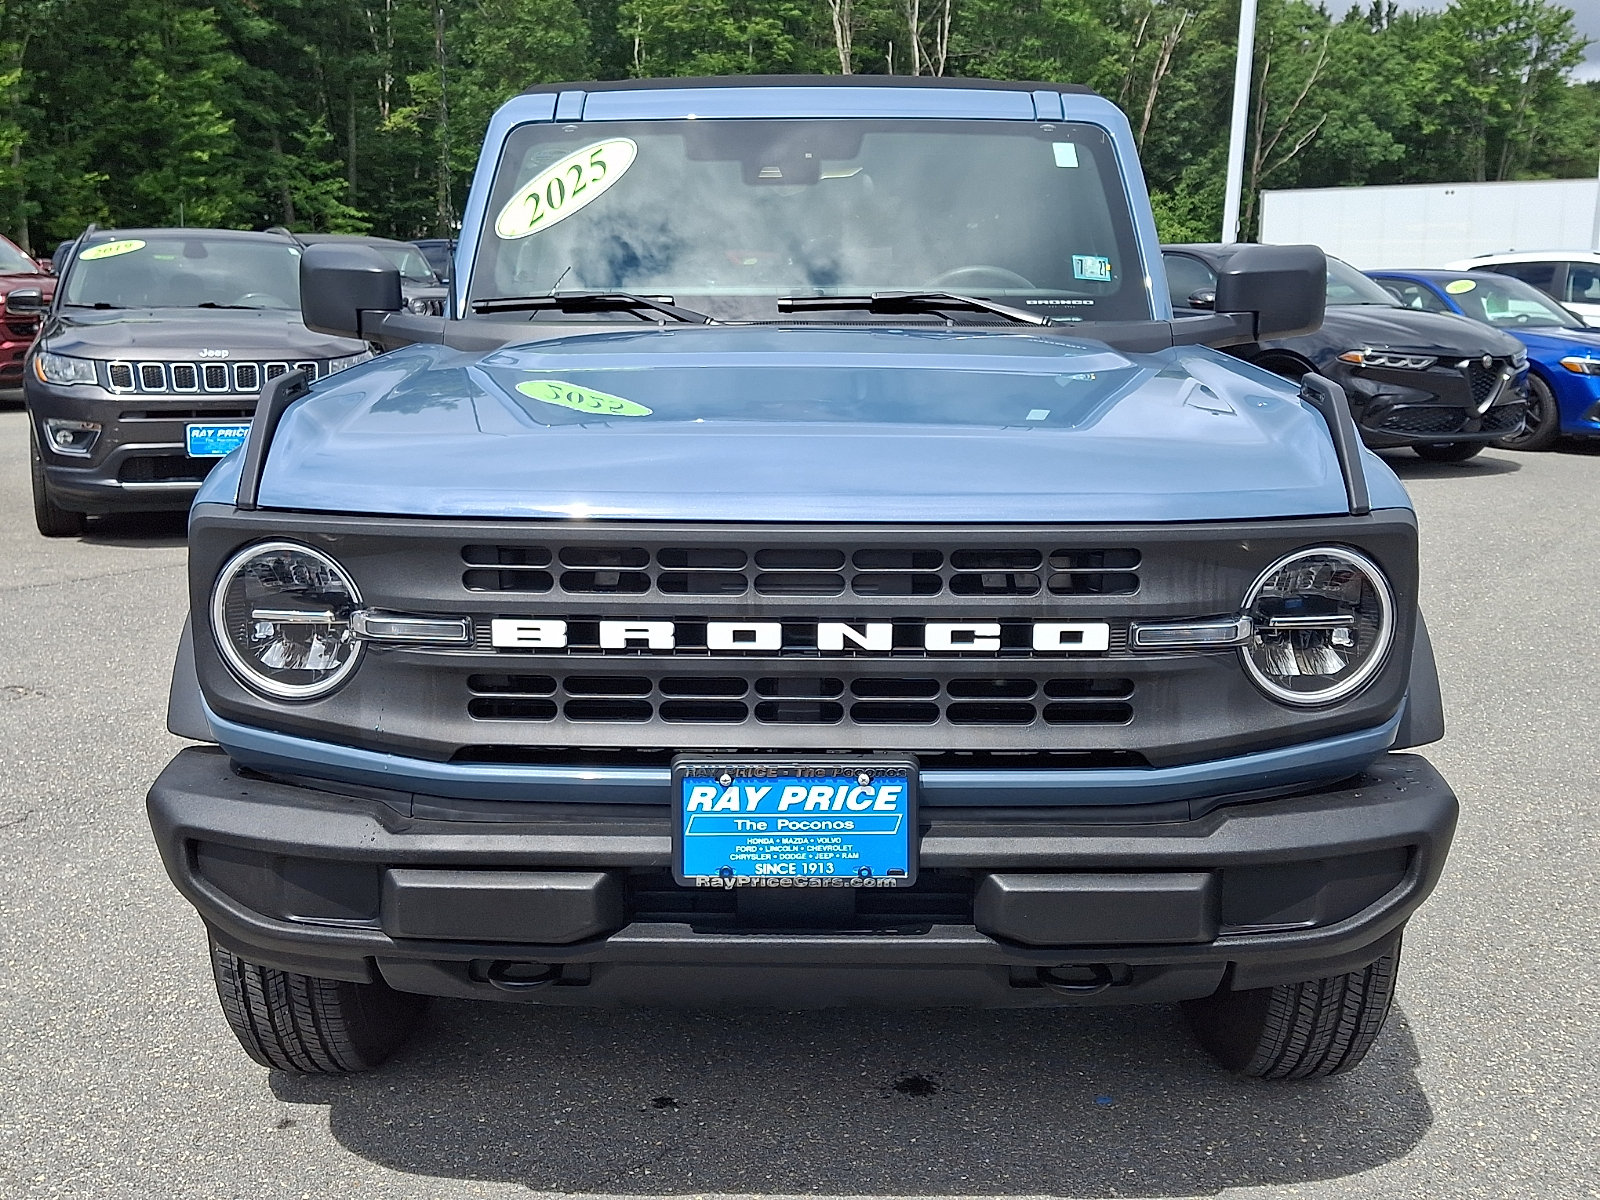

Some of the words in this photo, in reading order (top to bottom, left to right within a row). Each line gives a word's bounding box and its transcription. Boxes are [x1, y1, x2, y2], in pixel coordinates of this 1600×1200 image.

[523, 148, 607, 228] 2025
[199, 348, 229, 359] Jeep
[191, 429, 215, 438] RAY
[491, 619, 1110, 652] BRONCO
[685, 766, 722, 778] RAY
[724, 766, 778, 778] PRICE
[796, 766, 826, 777] The
[832, 766, 907, 777] Poconos
[686, 785, 772, 812] RAY
[777, 785, 903, 812] PRICE
[734, 819, 768, 831] The
[777, 819, 855, 831] Poconos
[730, 853, 772, 861] CHRYSLER
[755, 862, 797, 875] SINCE
[802, 862, 835, 874] 1913
[695, 874, 897, 890] RayPriceCars.com
